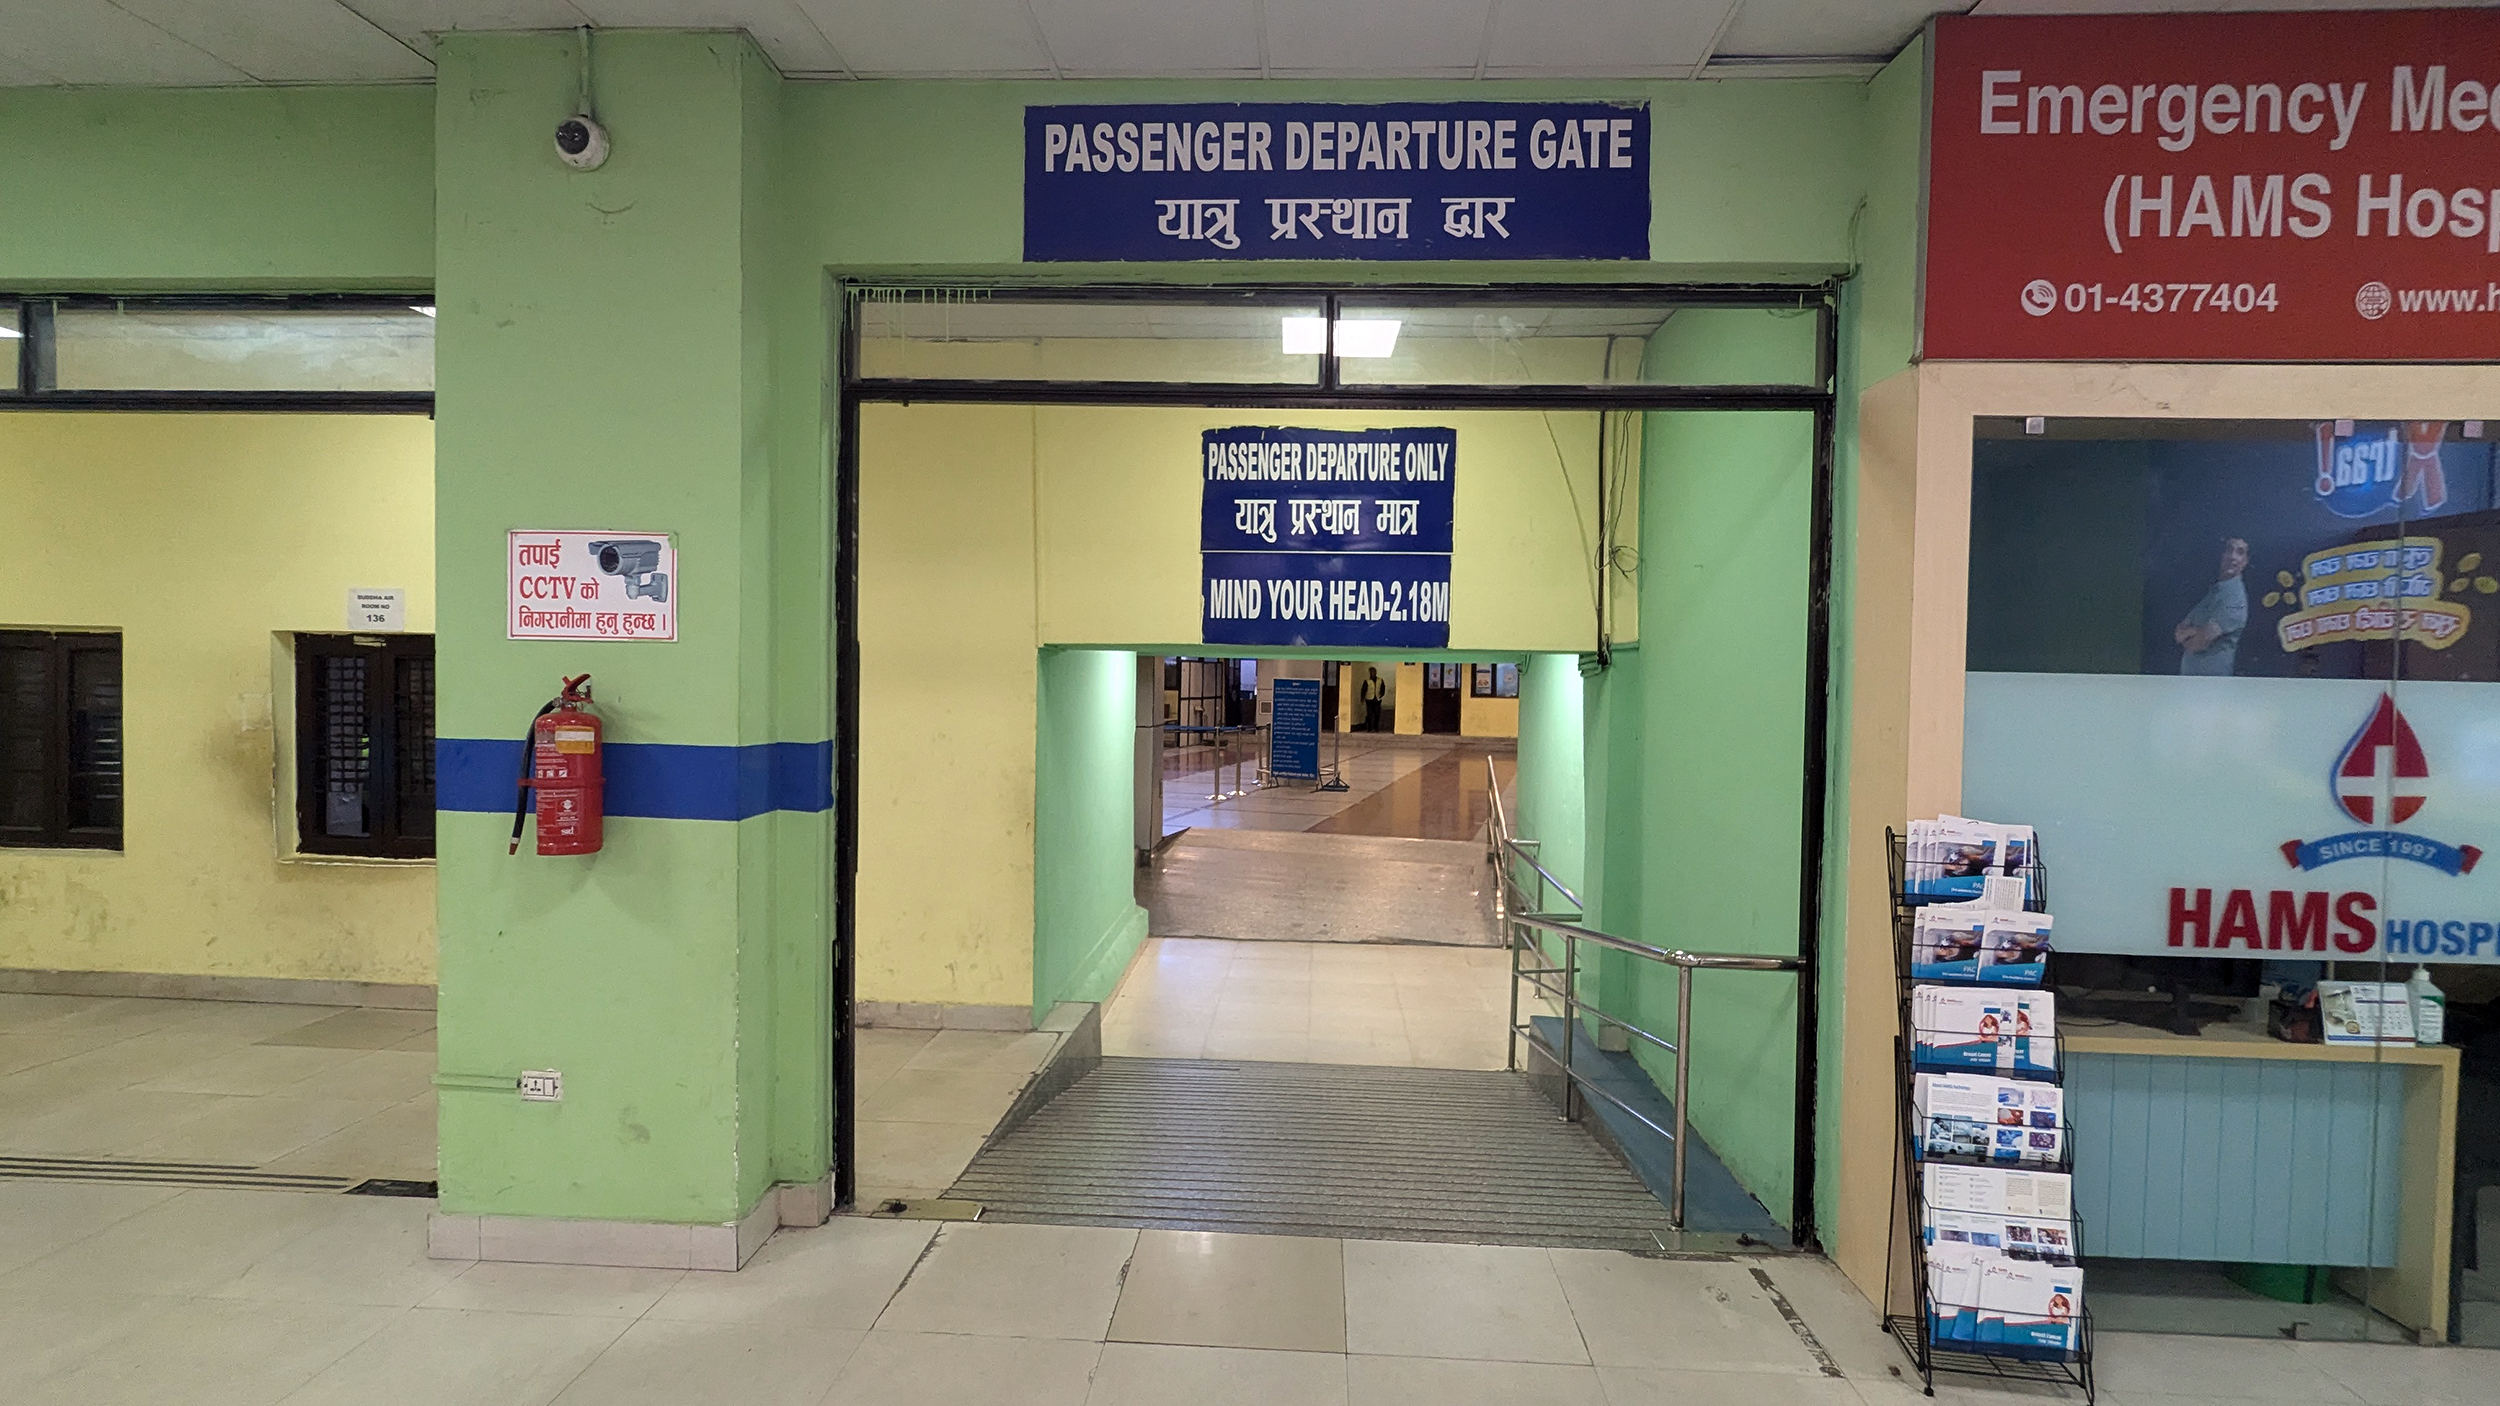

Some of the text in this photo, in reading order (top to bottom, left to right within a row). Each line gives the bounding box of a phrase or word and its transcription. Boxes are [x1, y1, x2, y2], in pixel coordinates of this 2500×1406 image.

[1980, 65, 2500, 152] Emergency Me
[1045, 118, 1633, 173] PASSENGER DEPARTURE GATE
[1154, 197, 1516, 249] यात्रु प्रस्थान द्वार
[2103, 173, 2332, 254] (HAMS
[2064, 282, 2279, 313] 01-4377404
[1208, 442, 1449, 482] PASSENGER DEPARTURE ONLY
[1234, 499, 1420, 543] यात्रु प्रस्थान मात्र
[518, 539, 562, 569] तपाई
[519, 575, 600, 600] CCTV को
[1210, 578, 1449, 622] MIND YOUR HEAD-2.18M
[366, 614, 385, 622] 136
[518, 605, 592, 630] निगरानीमा
[2319, 838, 2438, 860] SINCE 1997
[2167, 887, 2377, 953] HAMS
